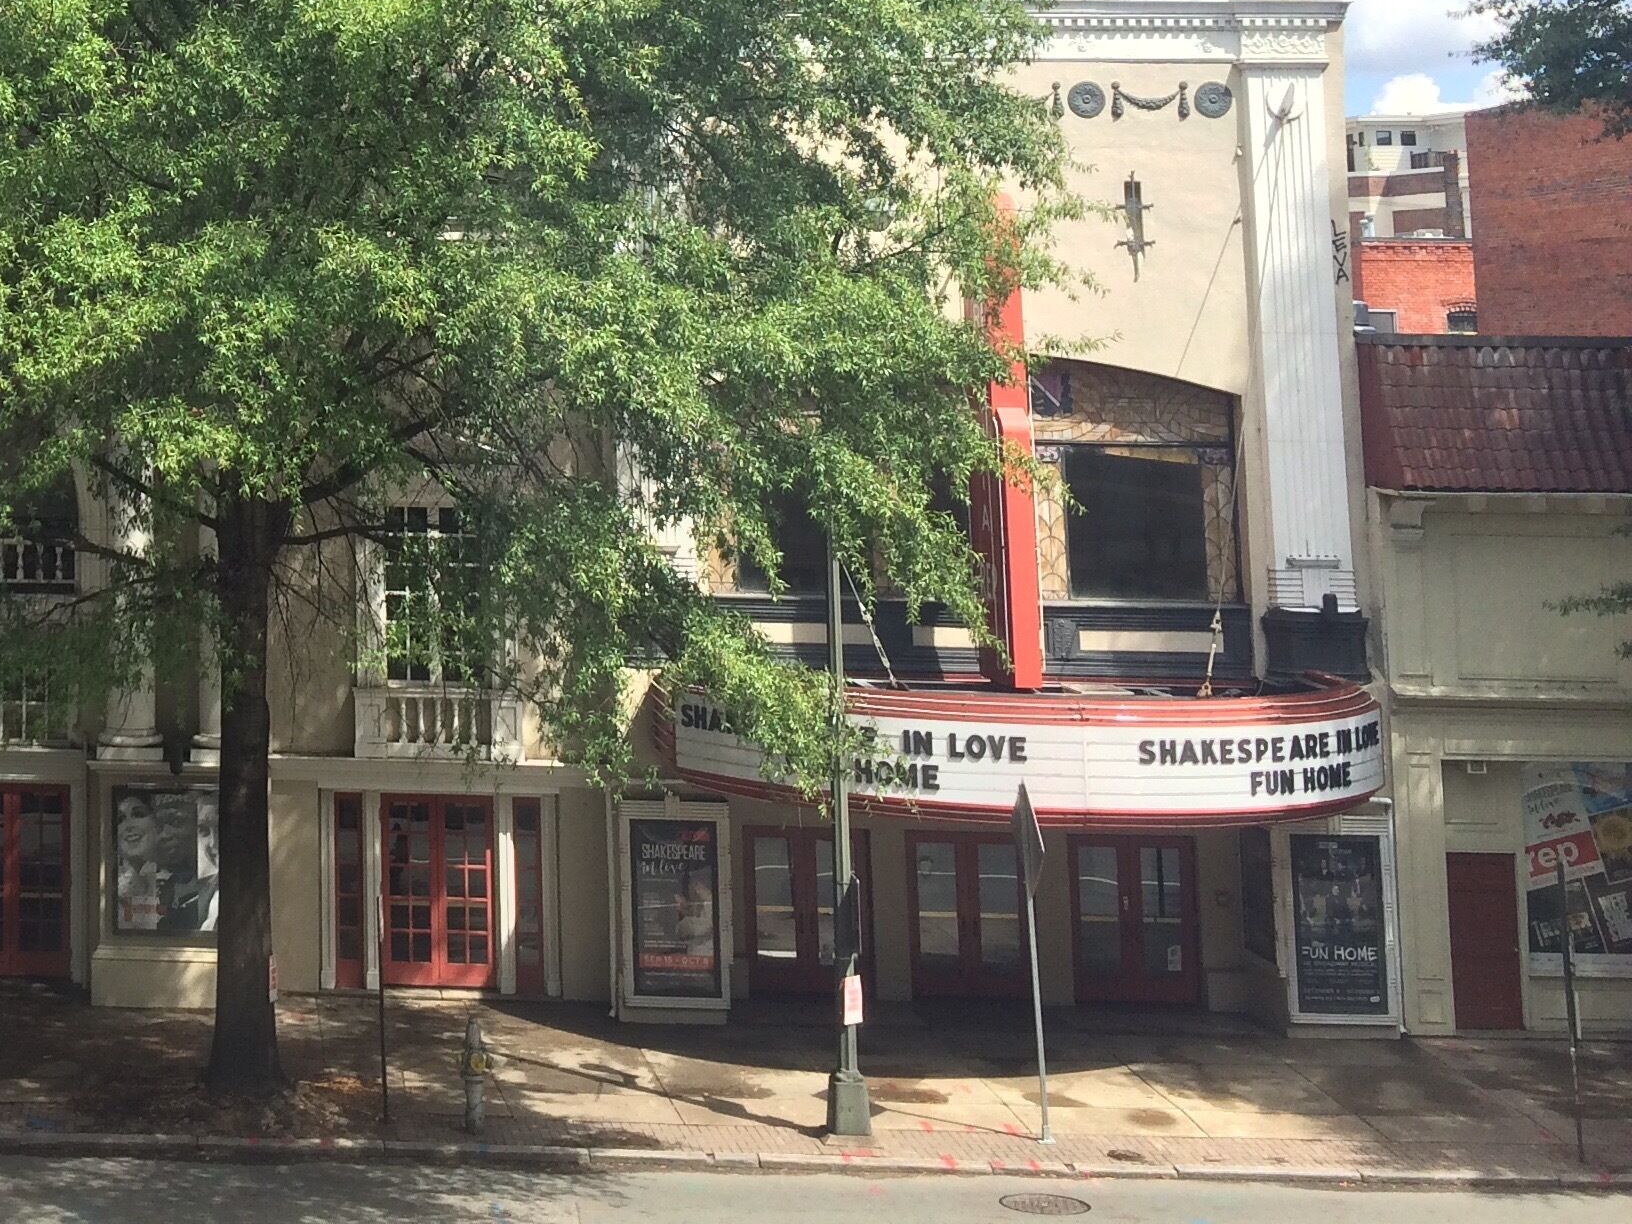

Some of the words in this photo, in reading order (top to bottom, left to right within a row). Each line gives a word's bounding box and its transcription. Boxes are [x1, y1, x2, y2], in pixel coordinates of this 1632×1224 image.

[1331, 219, 1349, 285] LEVA
[903, 729, 933, 756] IN
[949, 733, 1028, 762] LOVE
[1139, 732, 1330, 764] SHAKESPEARE
[1336, 728, 1352, 755] IN
[1355, 720, 1379, 752] LOVE
[854, 758, 940, 790] HOME
[1250, 769, 1295, 796] FUN
[1303, 761, 1352, 793] HOME
[641, 843, 706, 861] SHAKESPEARE
[1301, 944, 1329, 960] FUN
[1334, 945, 1378, 961] HOME
